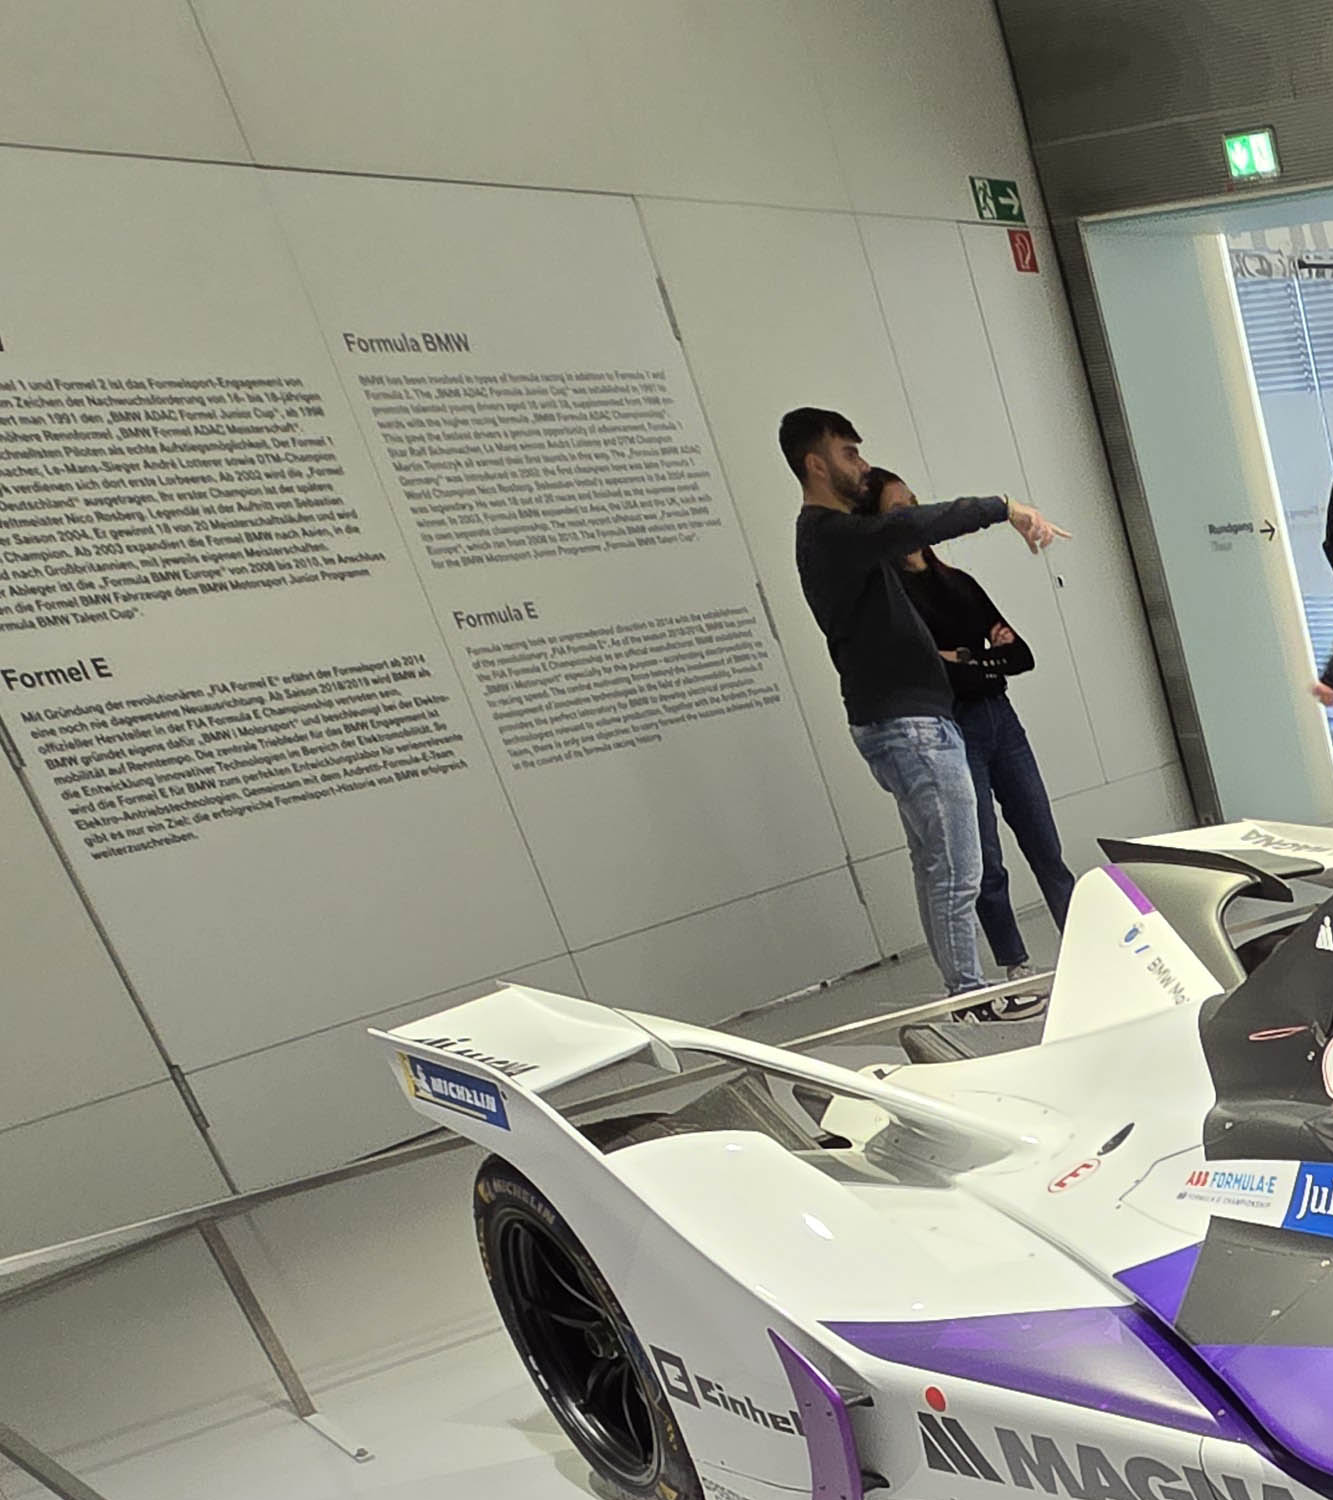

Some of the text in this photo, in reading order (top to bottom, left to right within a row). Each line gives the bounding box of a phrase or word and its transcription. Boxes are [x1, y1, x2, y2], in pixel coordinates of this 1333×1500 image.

[343, 333, 471, 353] Formula BMW
[453, 601, 539, 629] Formula E
[0, 657, 113, 692] Formel E
[430, 1076, 498, 1113] MICHELIN
[1186, 1170, 1209, 1187] ABB
